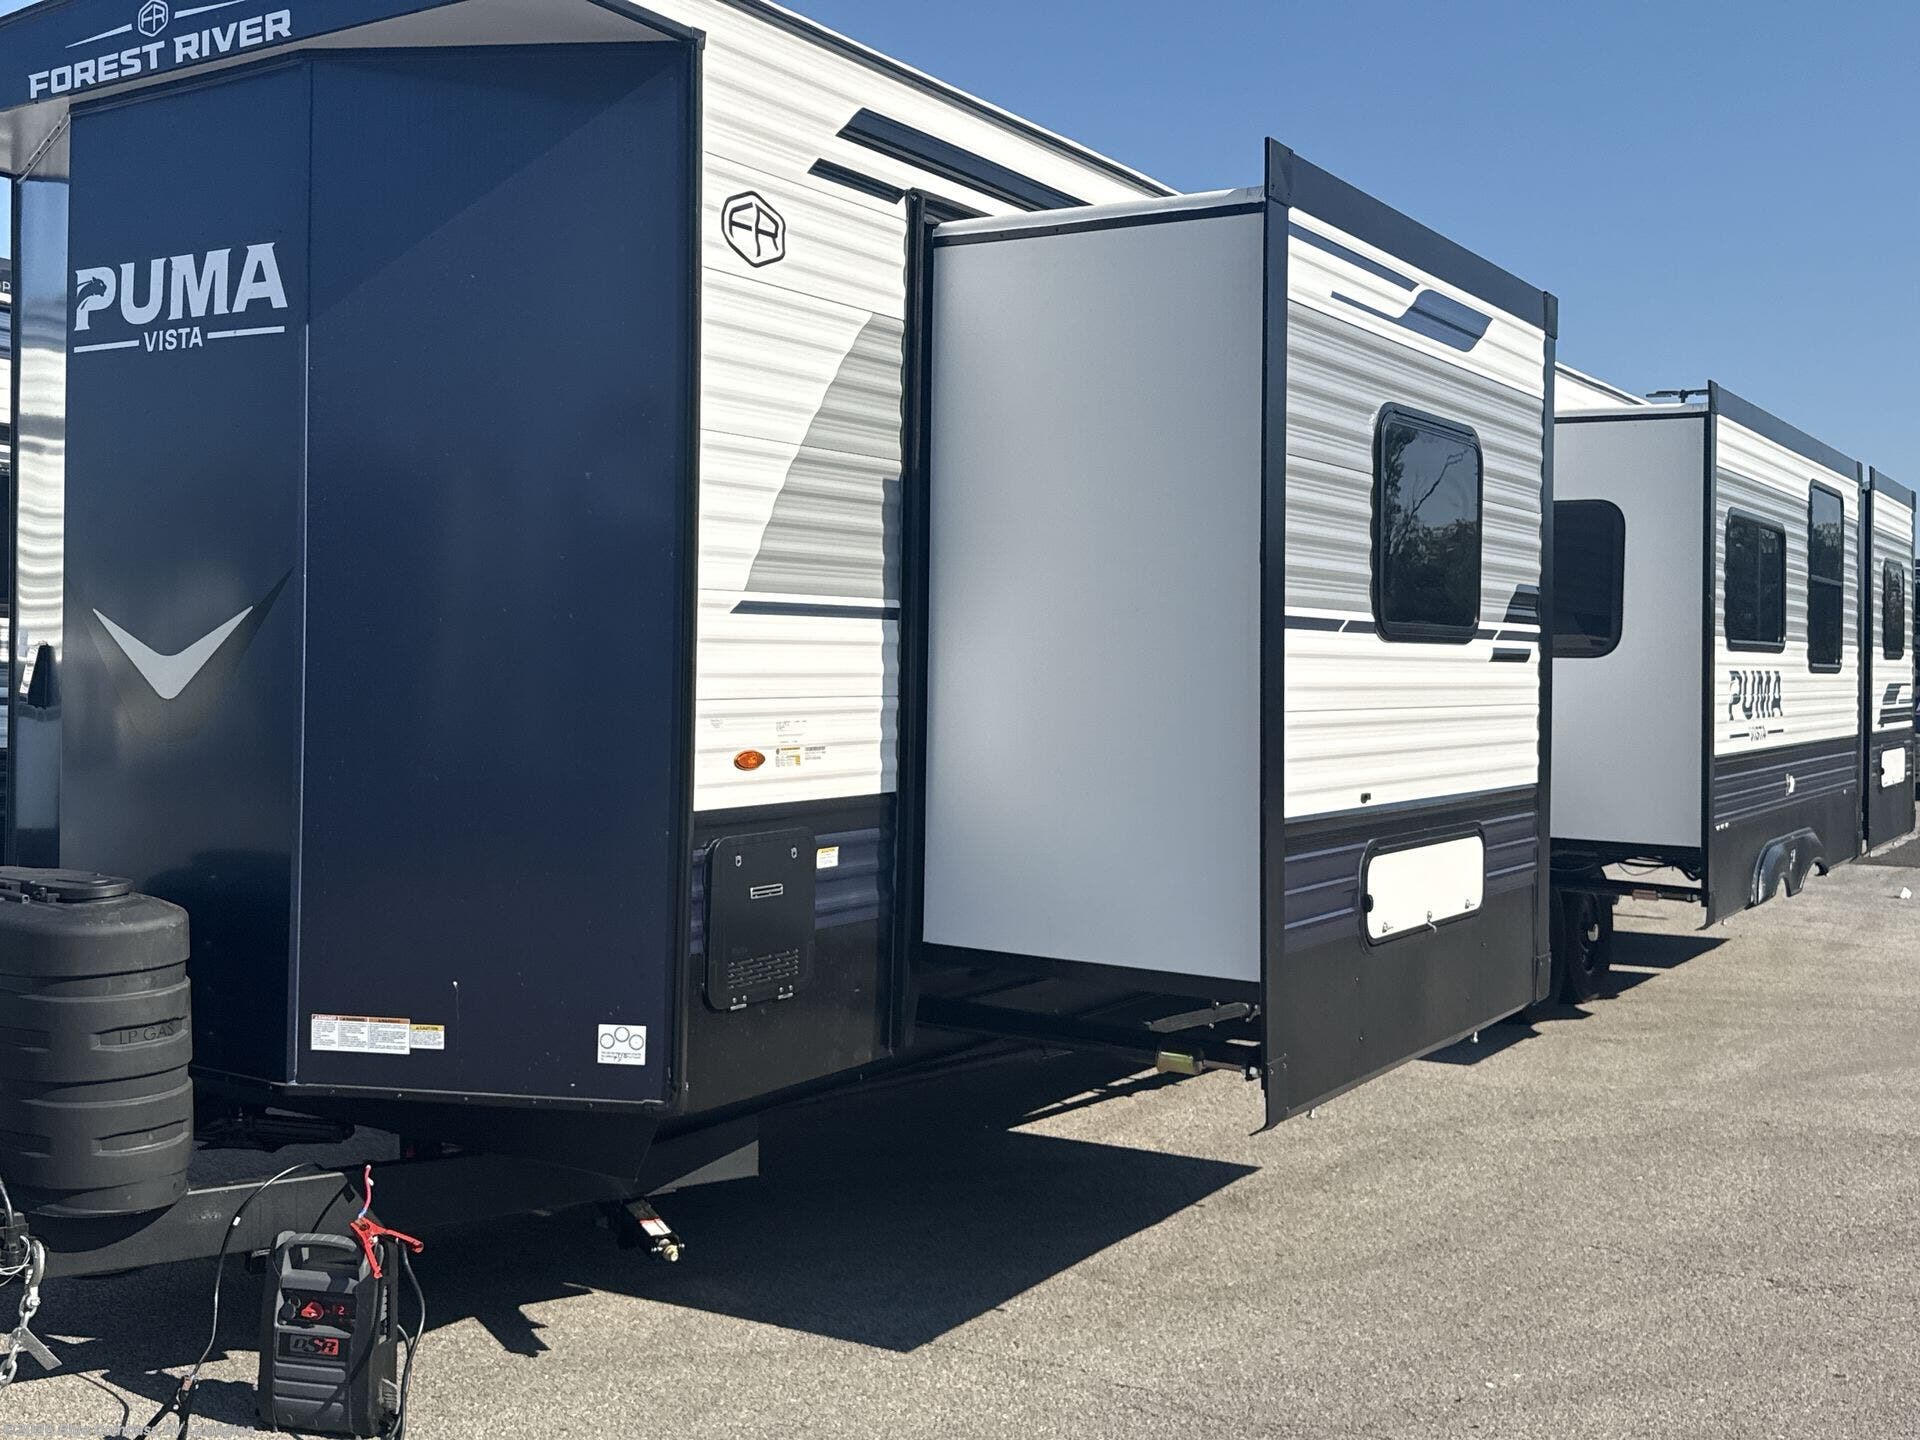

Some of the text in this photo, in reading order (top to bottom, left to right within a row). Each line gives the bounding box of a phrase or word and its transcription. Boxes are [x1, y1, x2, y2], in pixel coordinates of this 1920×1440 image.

[28, 9, 292, 100] FOREST RIVER
[74, 242, 288, 331] PUMA
[143, 326, 203, 352] VISTA
[1728, 670, 1783, 721] PUMA
[119, 1021, 176, 1044] LP GAS
